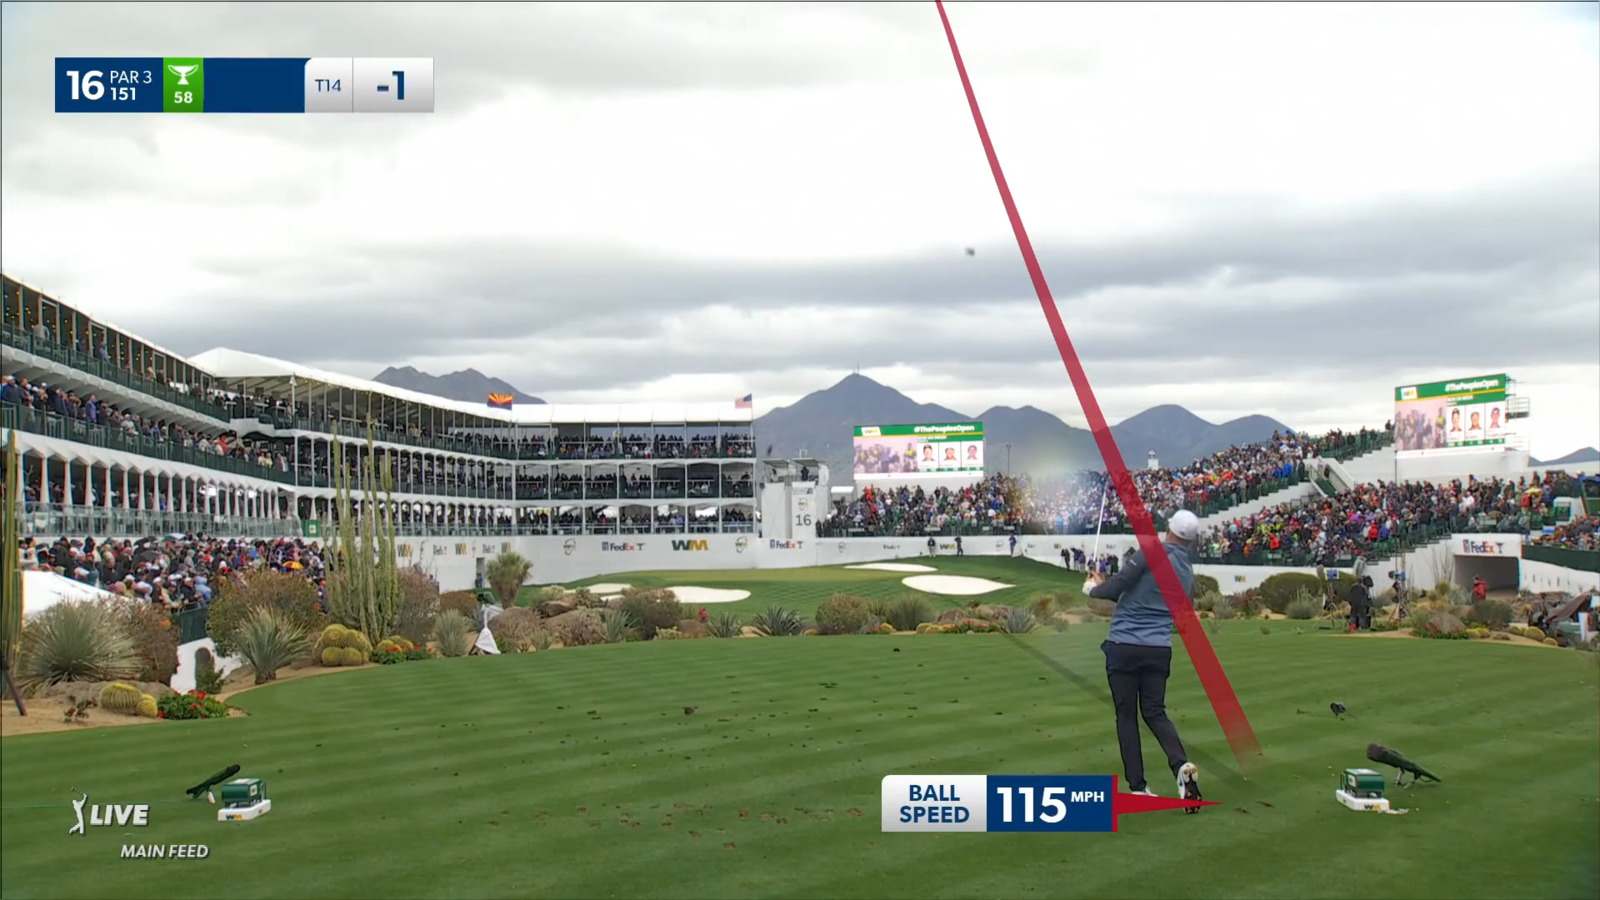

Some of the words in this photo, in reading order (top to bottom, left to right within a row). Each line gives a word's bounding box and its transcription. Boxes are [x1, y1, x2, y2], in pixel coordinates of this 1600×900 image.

[795, 514, 812, 527] 16
[610, 542, 634, 551] FedEx
[672, 539, 709, 551] WM
[1470, 541, 1495, 554] FedEx
